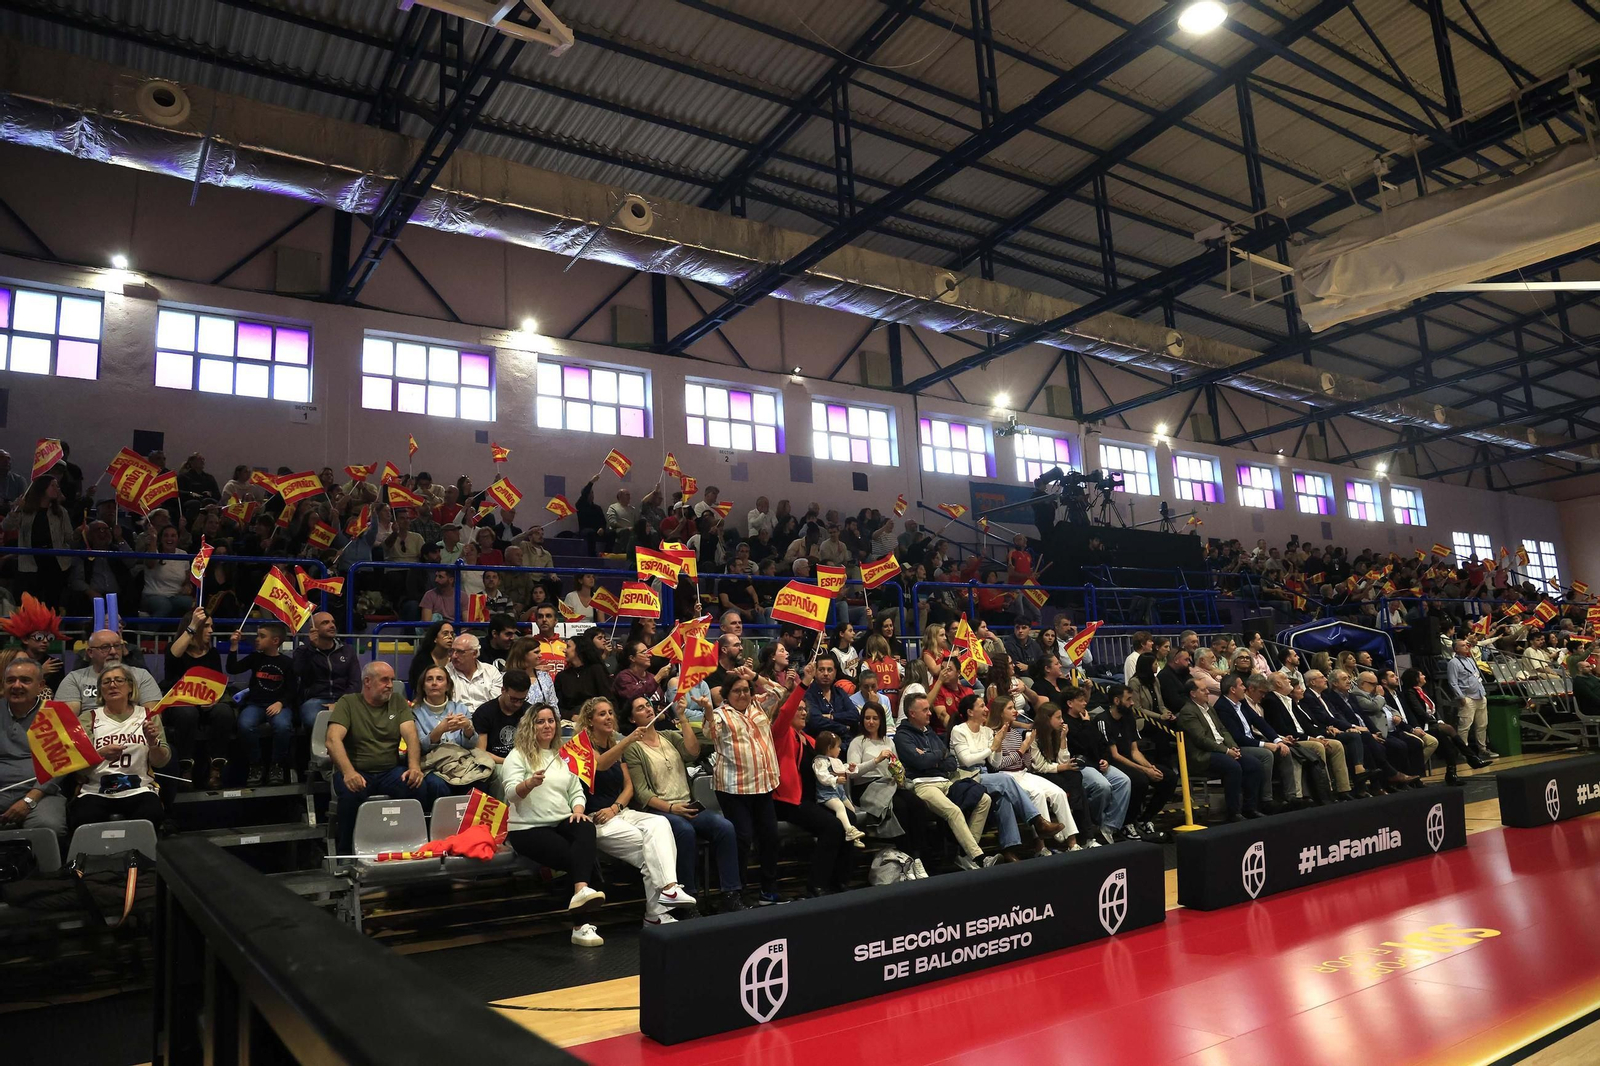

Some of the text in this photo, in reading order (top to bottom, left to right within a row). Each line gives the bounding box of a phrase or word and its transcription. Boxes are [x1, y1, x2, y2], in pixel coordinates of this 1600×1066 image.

[303, 412, 308, 420] 1
[34, 441, 59, 464] SPAÑA
[724, 455, 729, 463] 2
[121, 472, 145, 500] SPAÑA
[640, 560, 677, 580] ESPAÑA
[863, 561, 898, 583] ESPAÑA
[820, 576, 844, 588] ESPA
[776, 593, 818, 618] ESPAÑA
[1075, 637, 1091, 656] ESP
[962, 659, 977, 677] ESP
[682, 671, 708, 690] ESP
[882, 674, 892, 685] 9
[169, 680, 216, 703] PAÑA
[30, 710, 72, 771] SPAÑA
[108, 753, 132, 768] 20
[1576, 781, 1600, 805] #La
[1298, 826, 1402, 875] #LaFamilia
[1115, 872, 1124, 880] FEB
[853, 903, 1055, 963] SELECCIÓN ESPAÑOLA
[768, 943, 784, 955] FEB
[883, 931, 1033, 982] DE BALONCESTO
